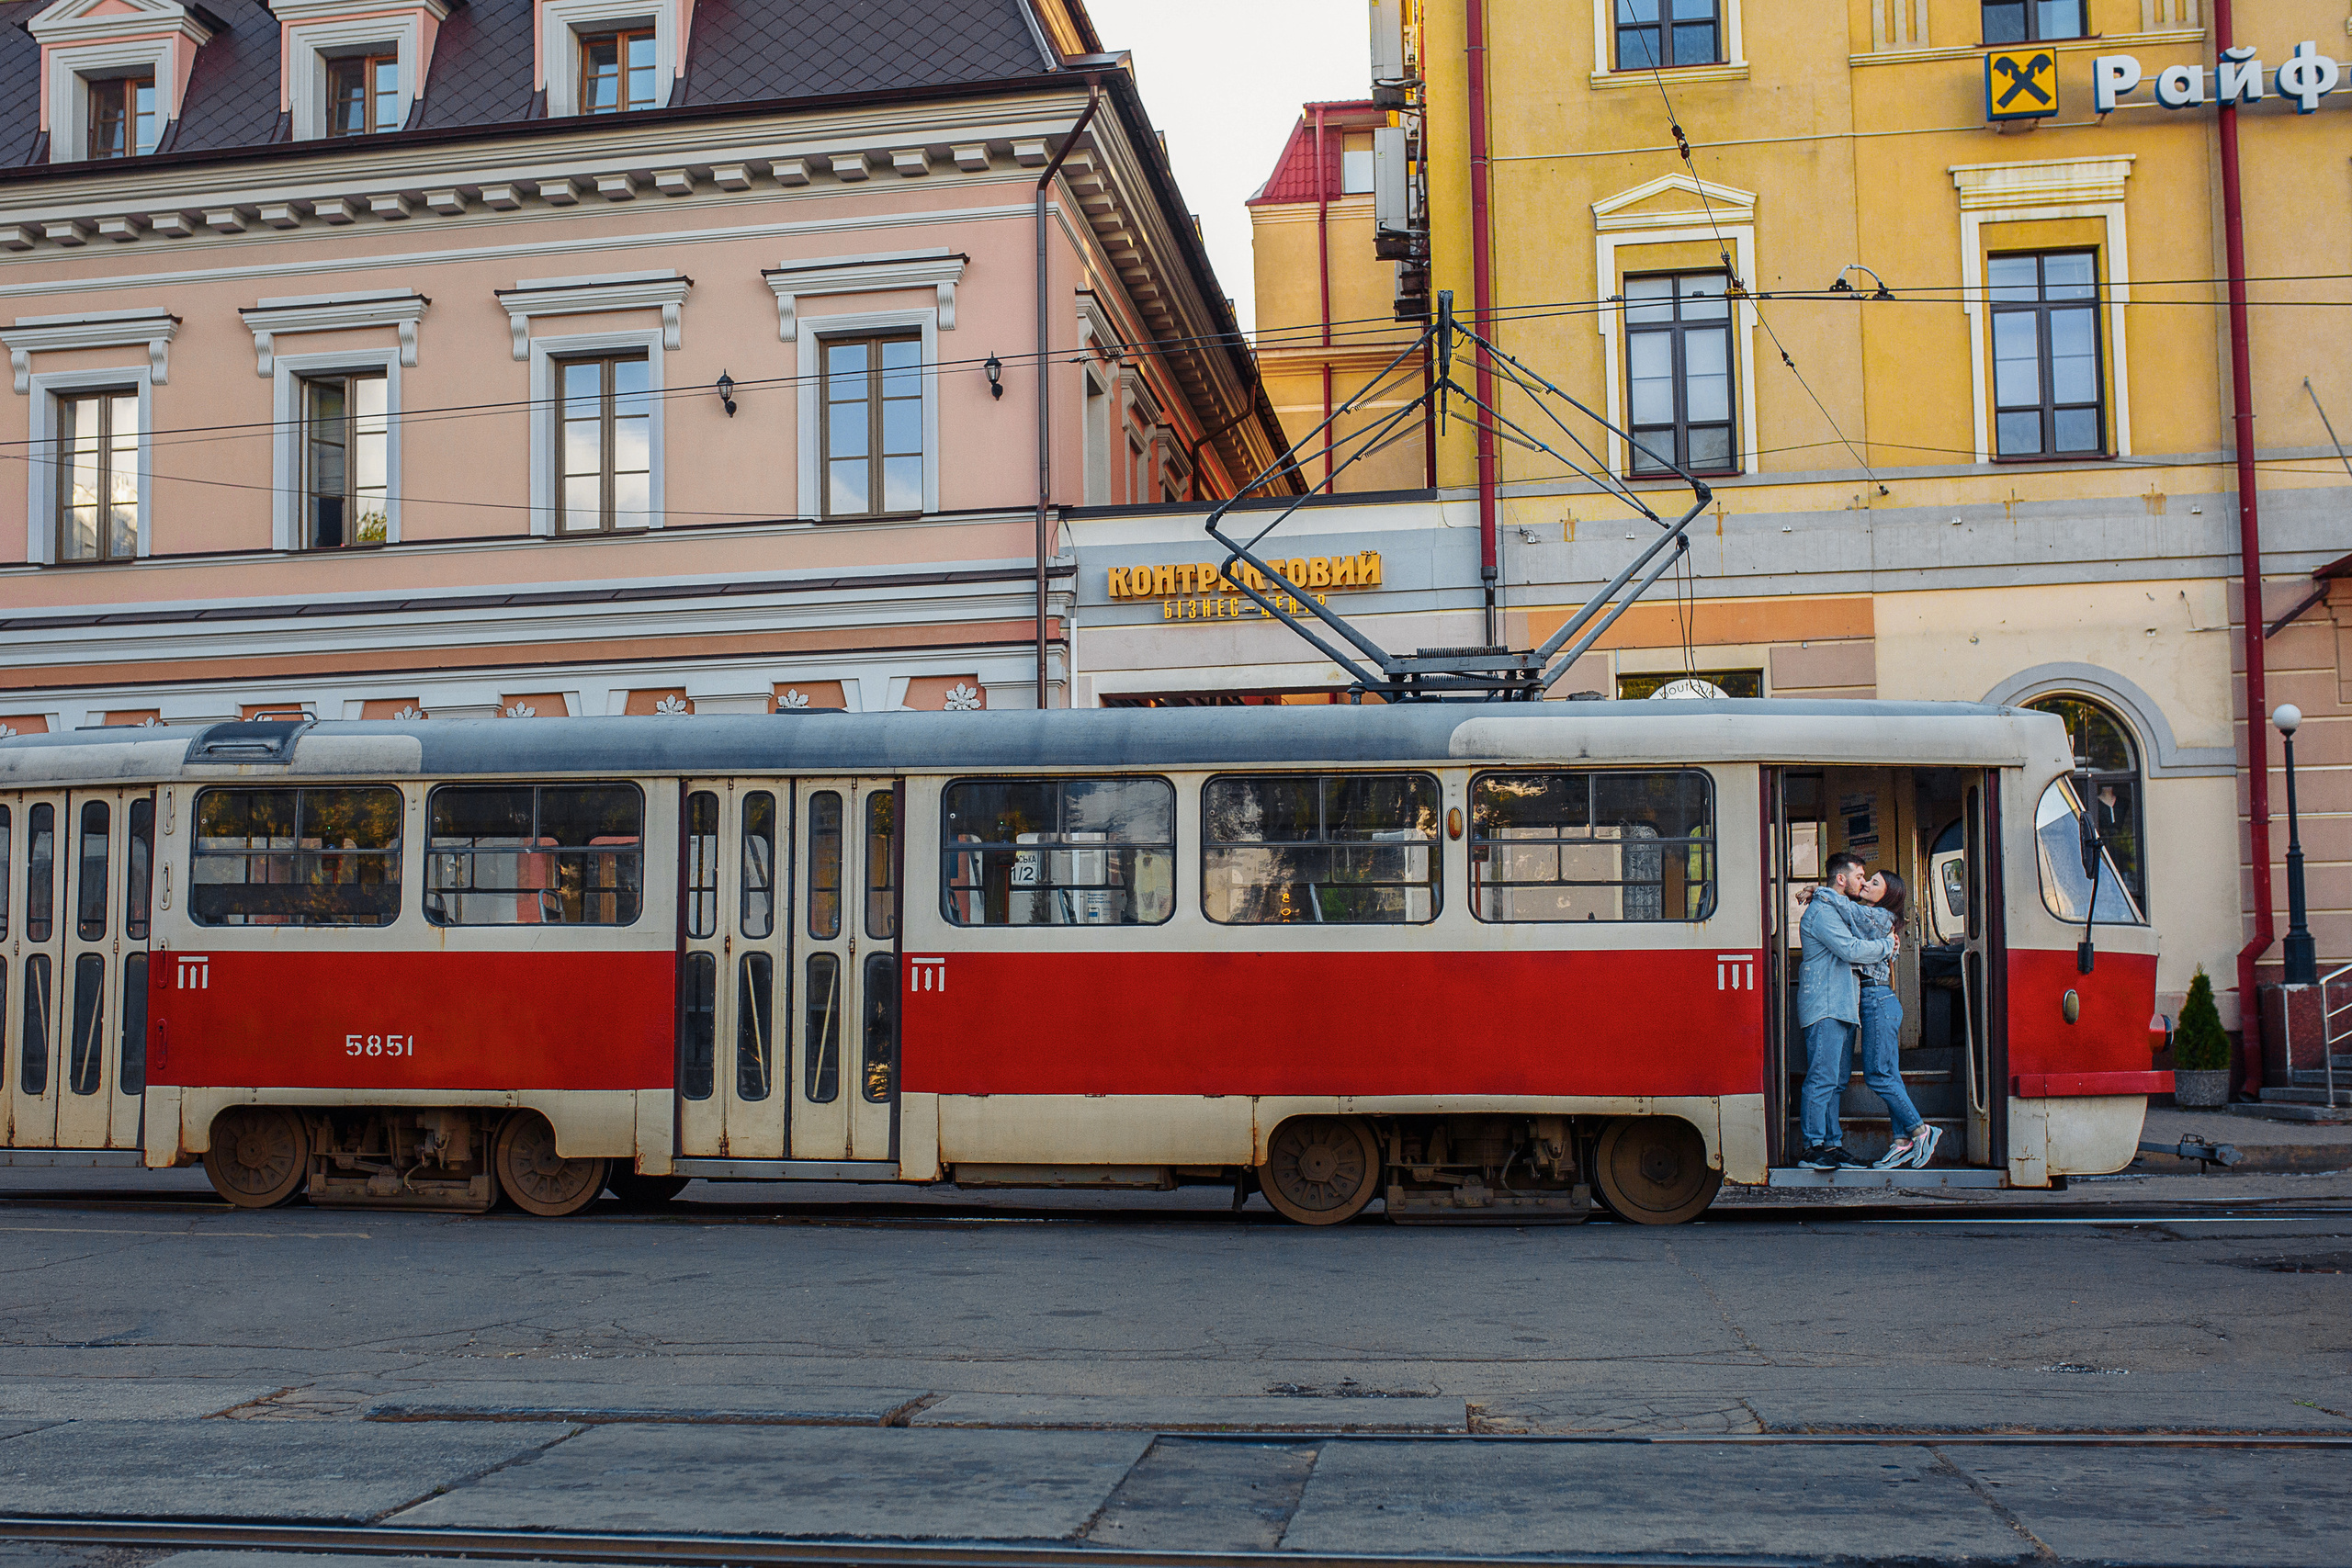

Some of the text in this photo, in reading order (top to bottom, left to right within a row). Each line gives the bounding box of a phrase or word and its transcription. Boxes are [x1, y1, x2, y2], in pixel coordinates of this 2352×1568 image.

[2095, 41, 2352, 114] Райф
[1108, 550, 1382, 598] КОНТРАКТОВИЙ
[1164, 593, 1326, 619] БІЗНЕС-ЦЕНР
[1016, 855, 1036, 863] СЬКА
[345, 1034, 413, 1056] 5851
